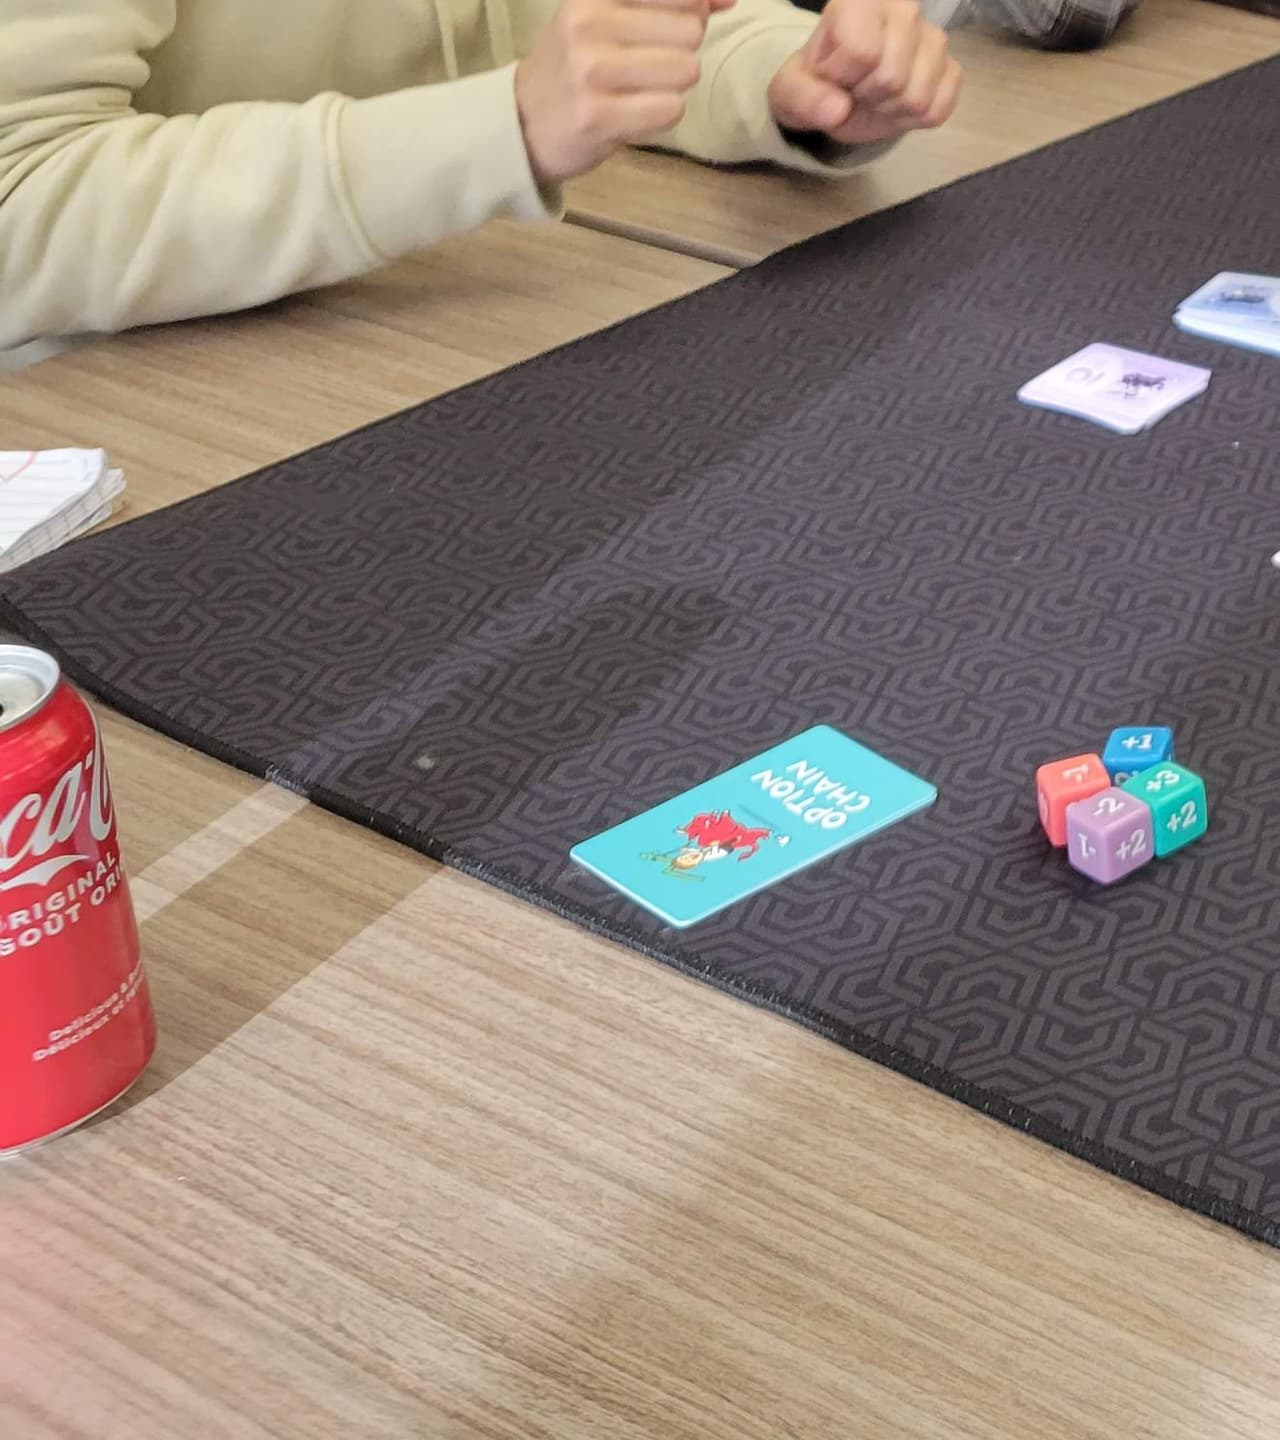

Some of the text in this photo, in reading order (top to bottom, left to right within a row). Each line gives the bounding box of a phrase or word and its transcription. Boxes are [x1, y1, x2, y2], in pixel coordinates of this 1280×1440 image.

[1122, 733, 1153, 750] +1
[751, 769, 848, 828] OPTION
[786, 759, 871, 812] CHAIN
[1166, 800, 1197, 832] +2
[1116, 829, 1147, 860] +2
[2, 852, 115, 930] RIGINAL
